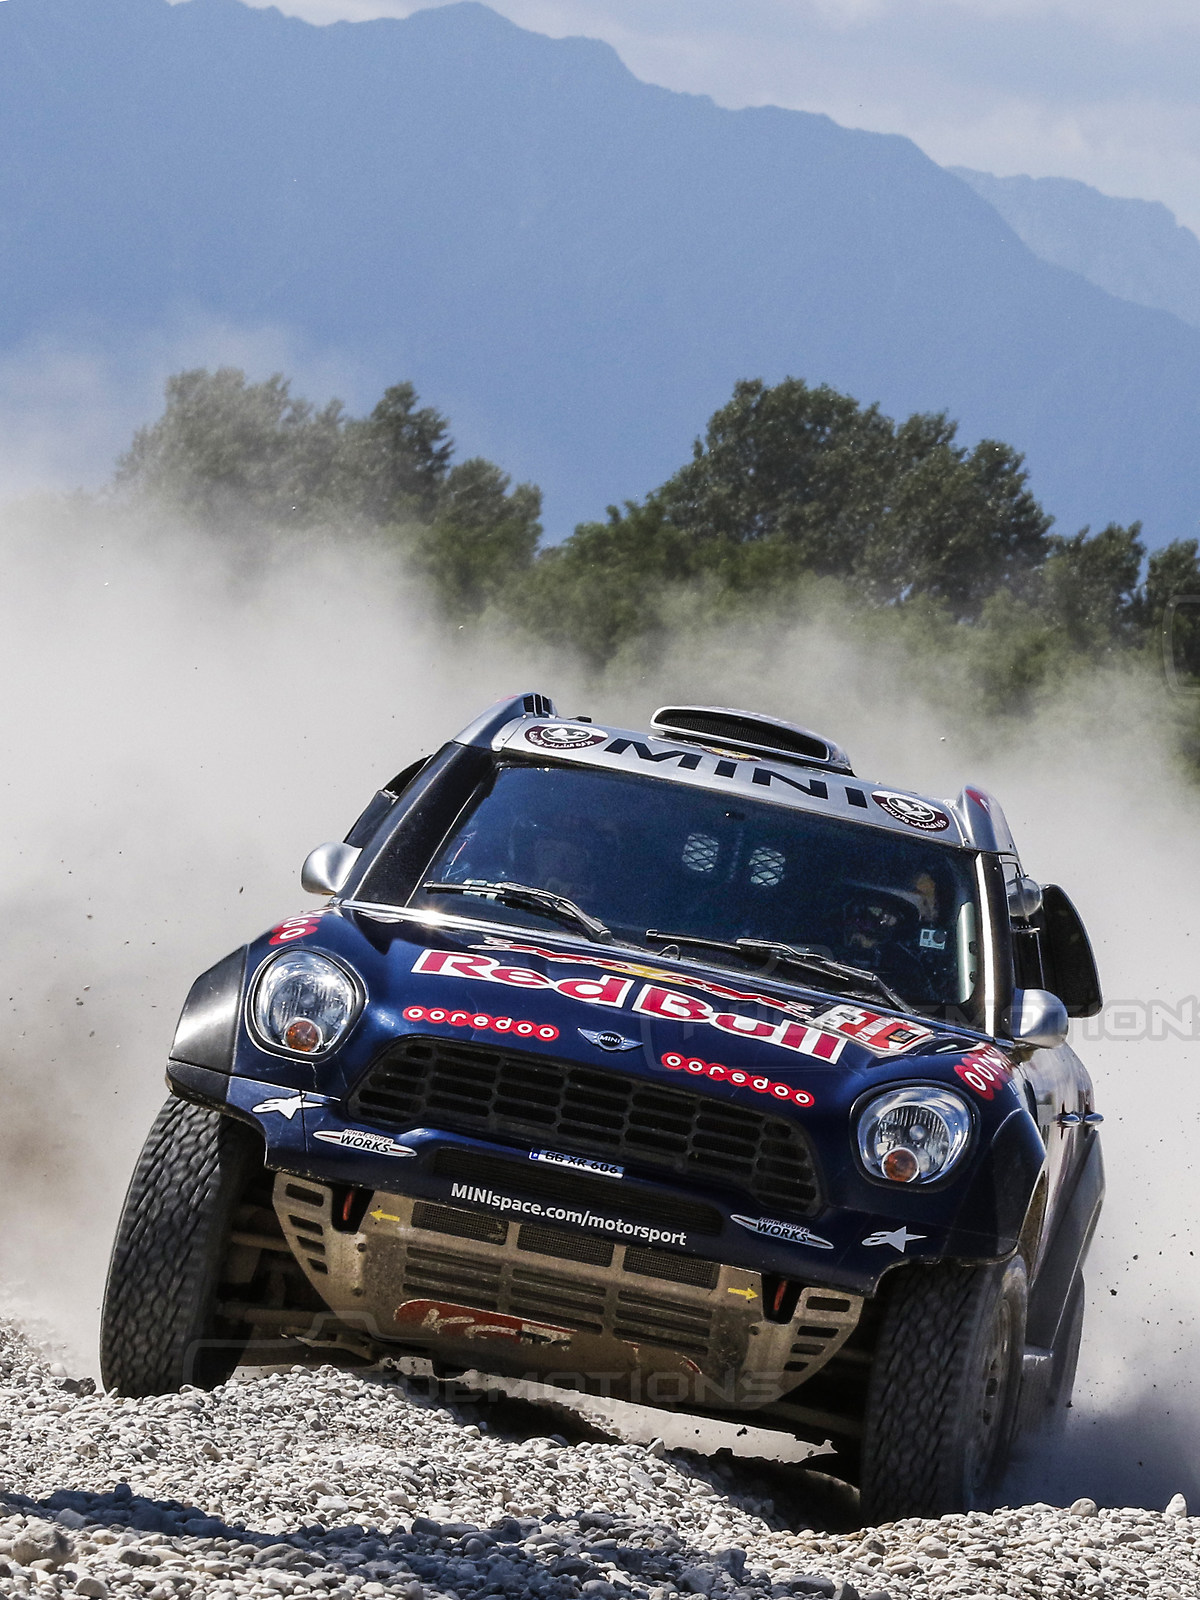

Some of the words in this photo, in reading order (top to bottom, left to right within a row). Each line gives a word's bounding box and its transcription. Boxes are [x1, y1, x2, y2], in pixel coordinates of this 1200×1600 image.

[603, 738, 868, 808] MINI
[411, 949, 635, 1008] Red
[632, 984, 849, 1064] Bull
[406, 1007, 557, 1040] ooredoo
[600, 1034, 621, 1044] MINI
[664, 1053, 812, 1106] ooredoo
[339, 1134, 391, 1153] WORKS
[343, 1129, 364, 1138] JOHN
[364, 1132, 394, 1144] COOPER
[567, 1155, 588, 1168] XR
[590, 1162, 618, 1174] 606
[450, 1182, 687, 1246] MINIspace.com/motorsport
[756, 1221, 809, 1242] WORKS
[759, 1217, 780, 1226] JOHN
[781, 1221, 811, 1234] COOPER
